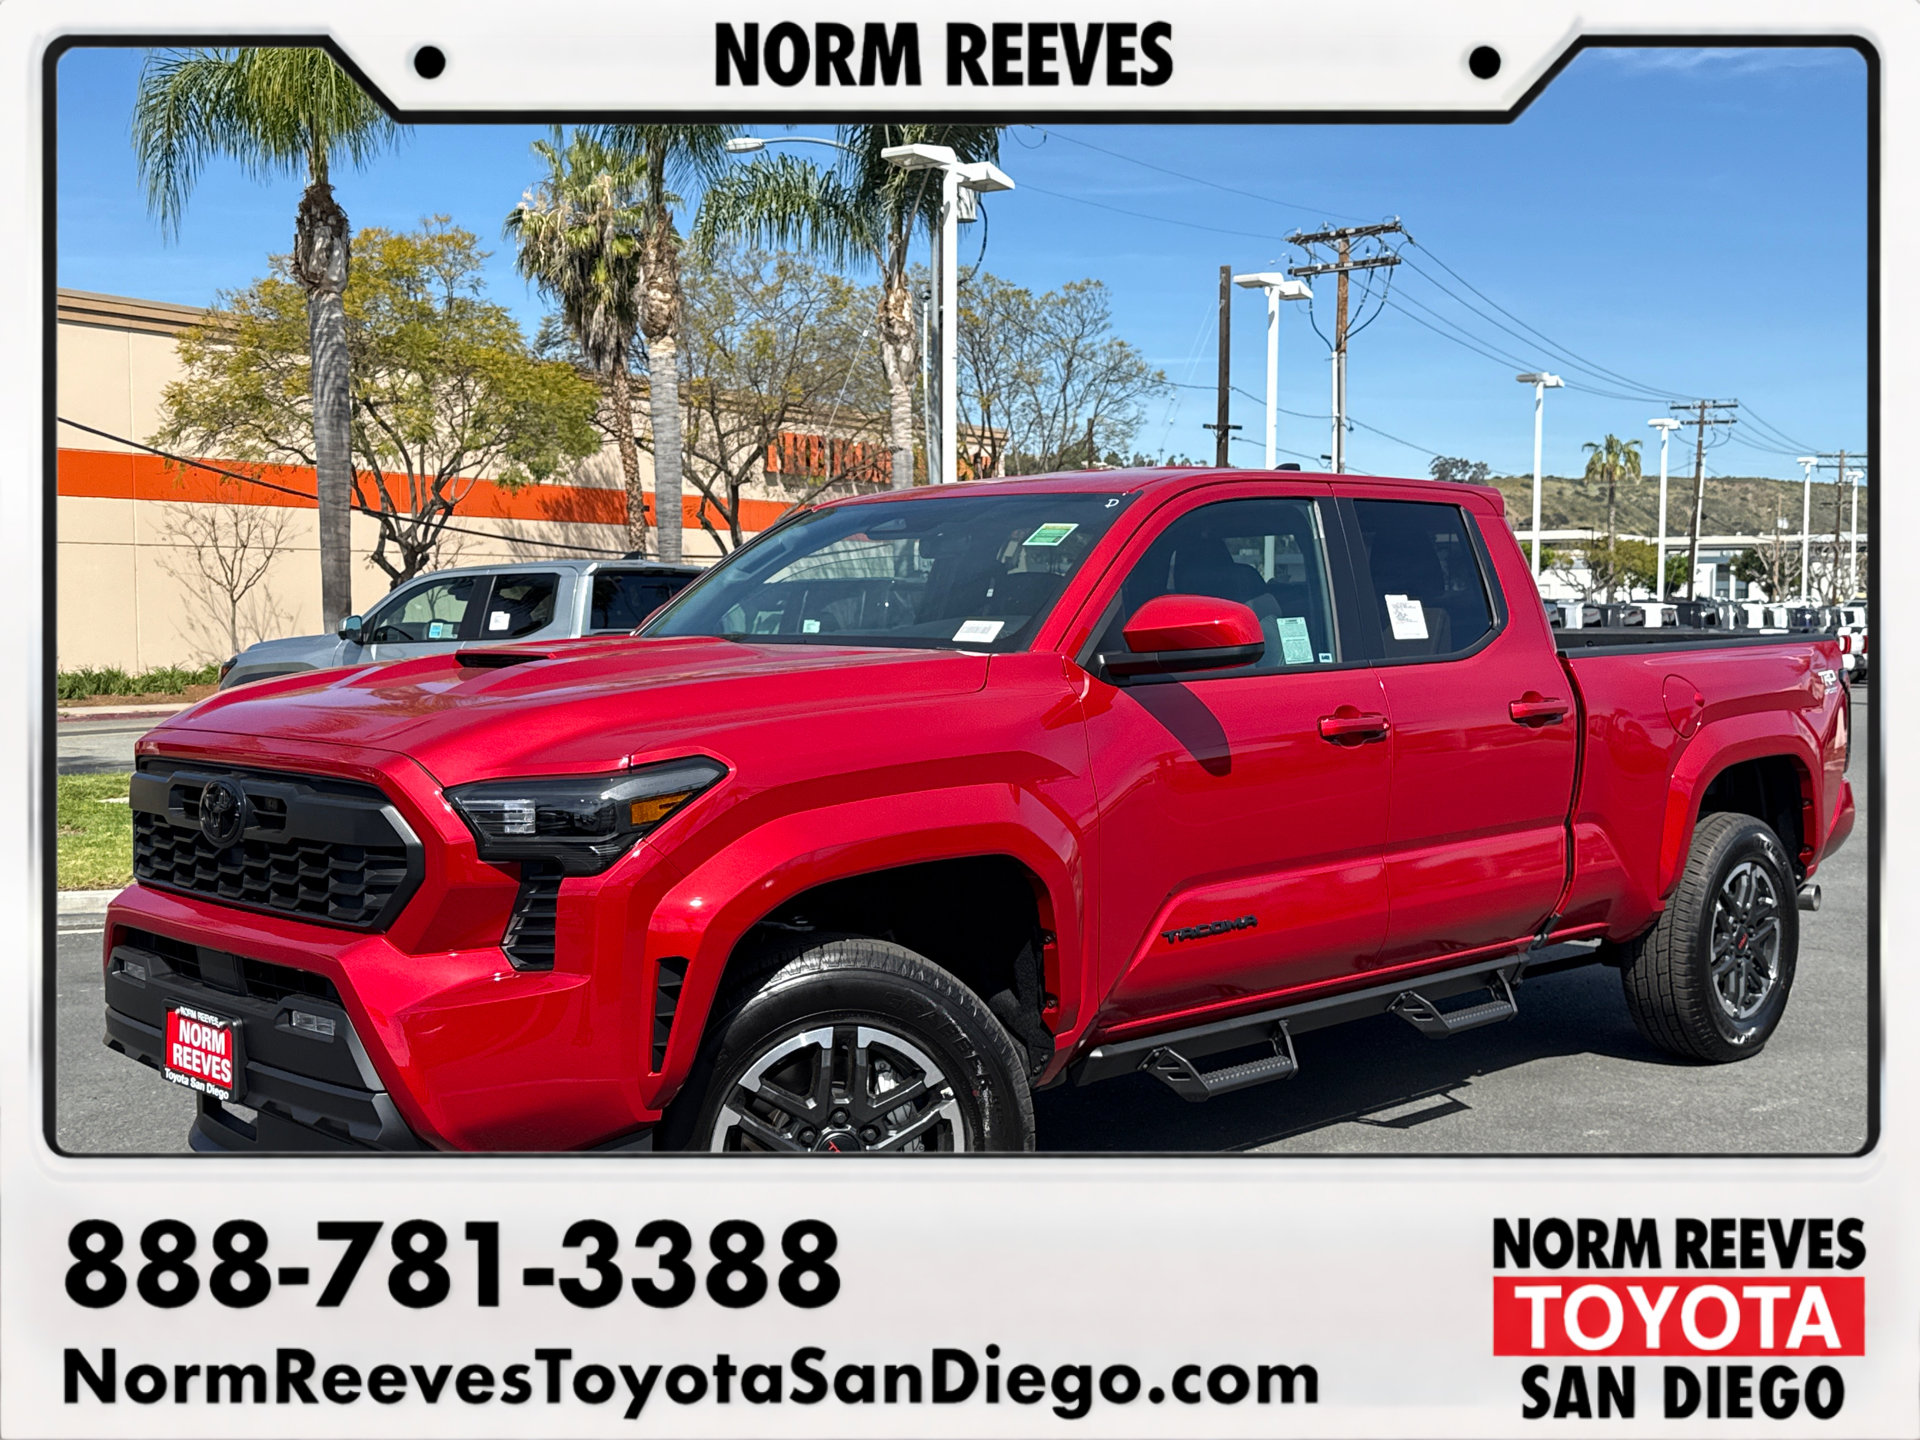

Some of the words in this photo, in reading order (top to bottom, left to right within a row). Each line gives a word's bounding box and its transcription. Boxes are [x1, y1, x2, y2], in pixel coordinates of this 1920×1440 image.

[1161, 914, 1258, 944] TACOMA
[179, 1019, 225, 1056] NORM
[172, 1042, 232, 1083] REEVES
[164, 1067, 190, 1086] Toyota
[190, 1077, 205, 1092] San
[206, 1082, 229, 1100] Diego
